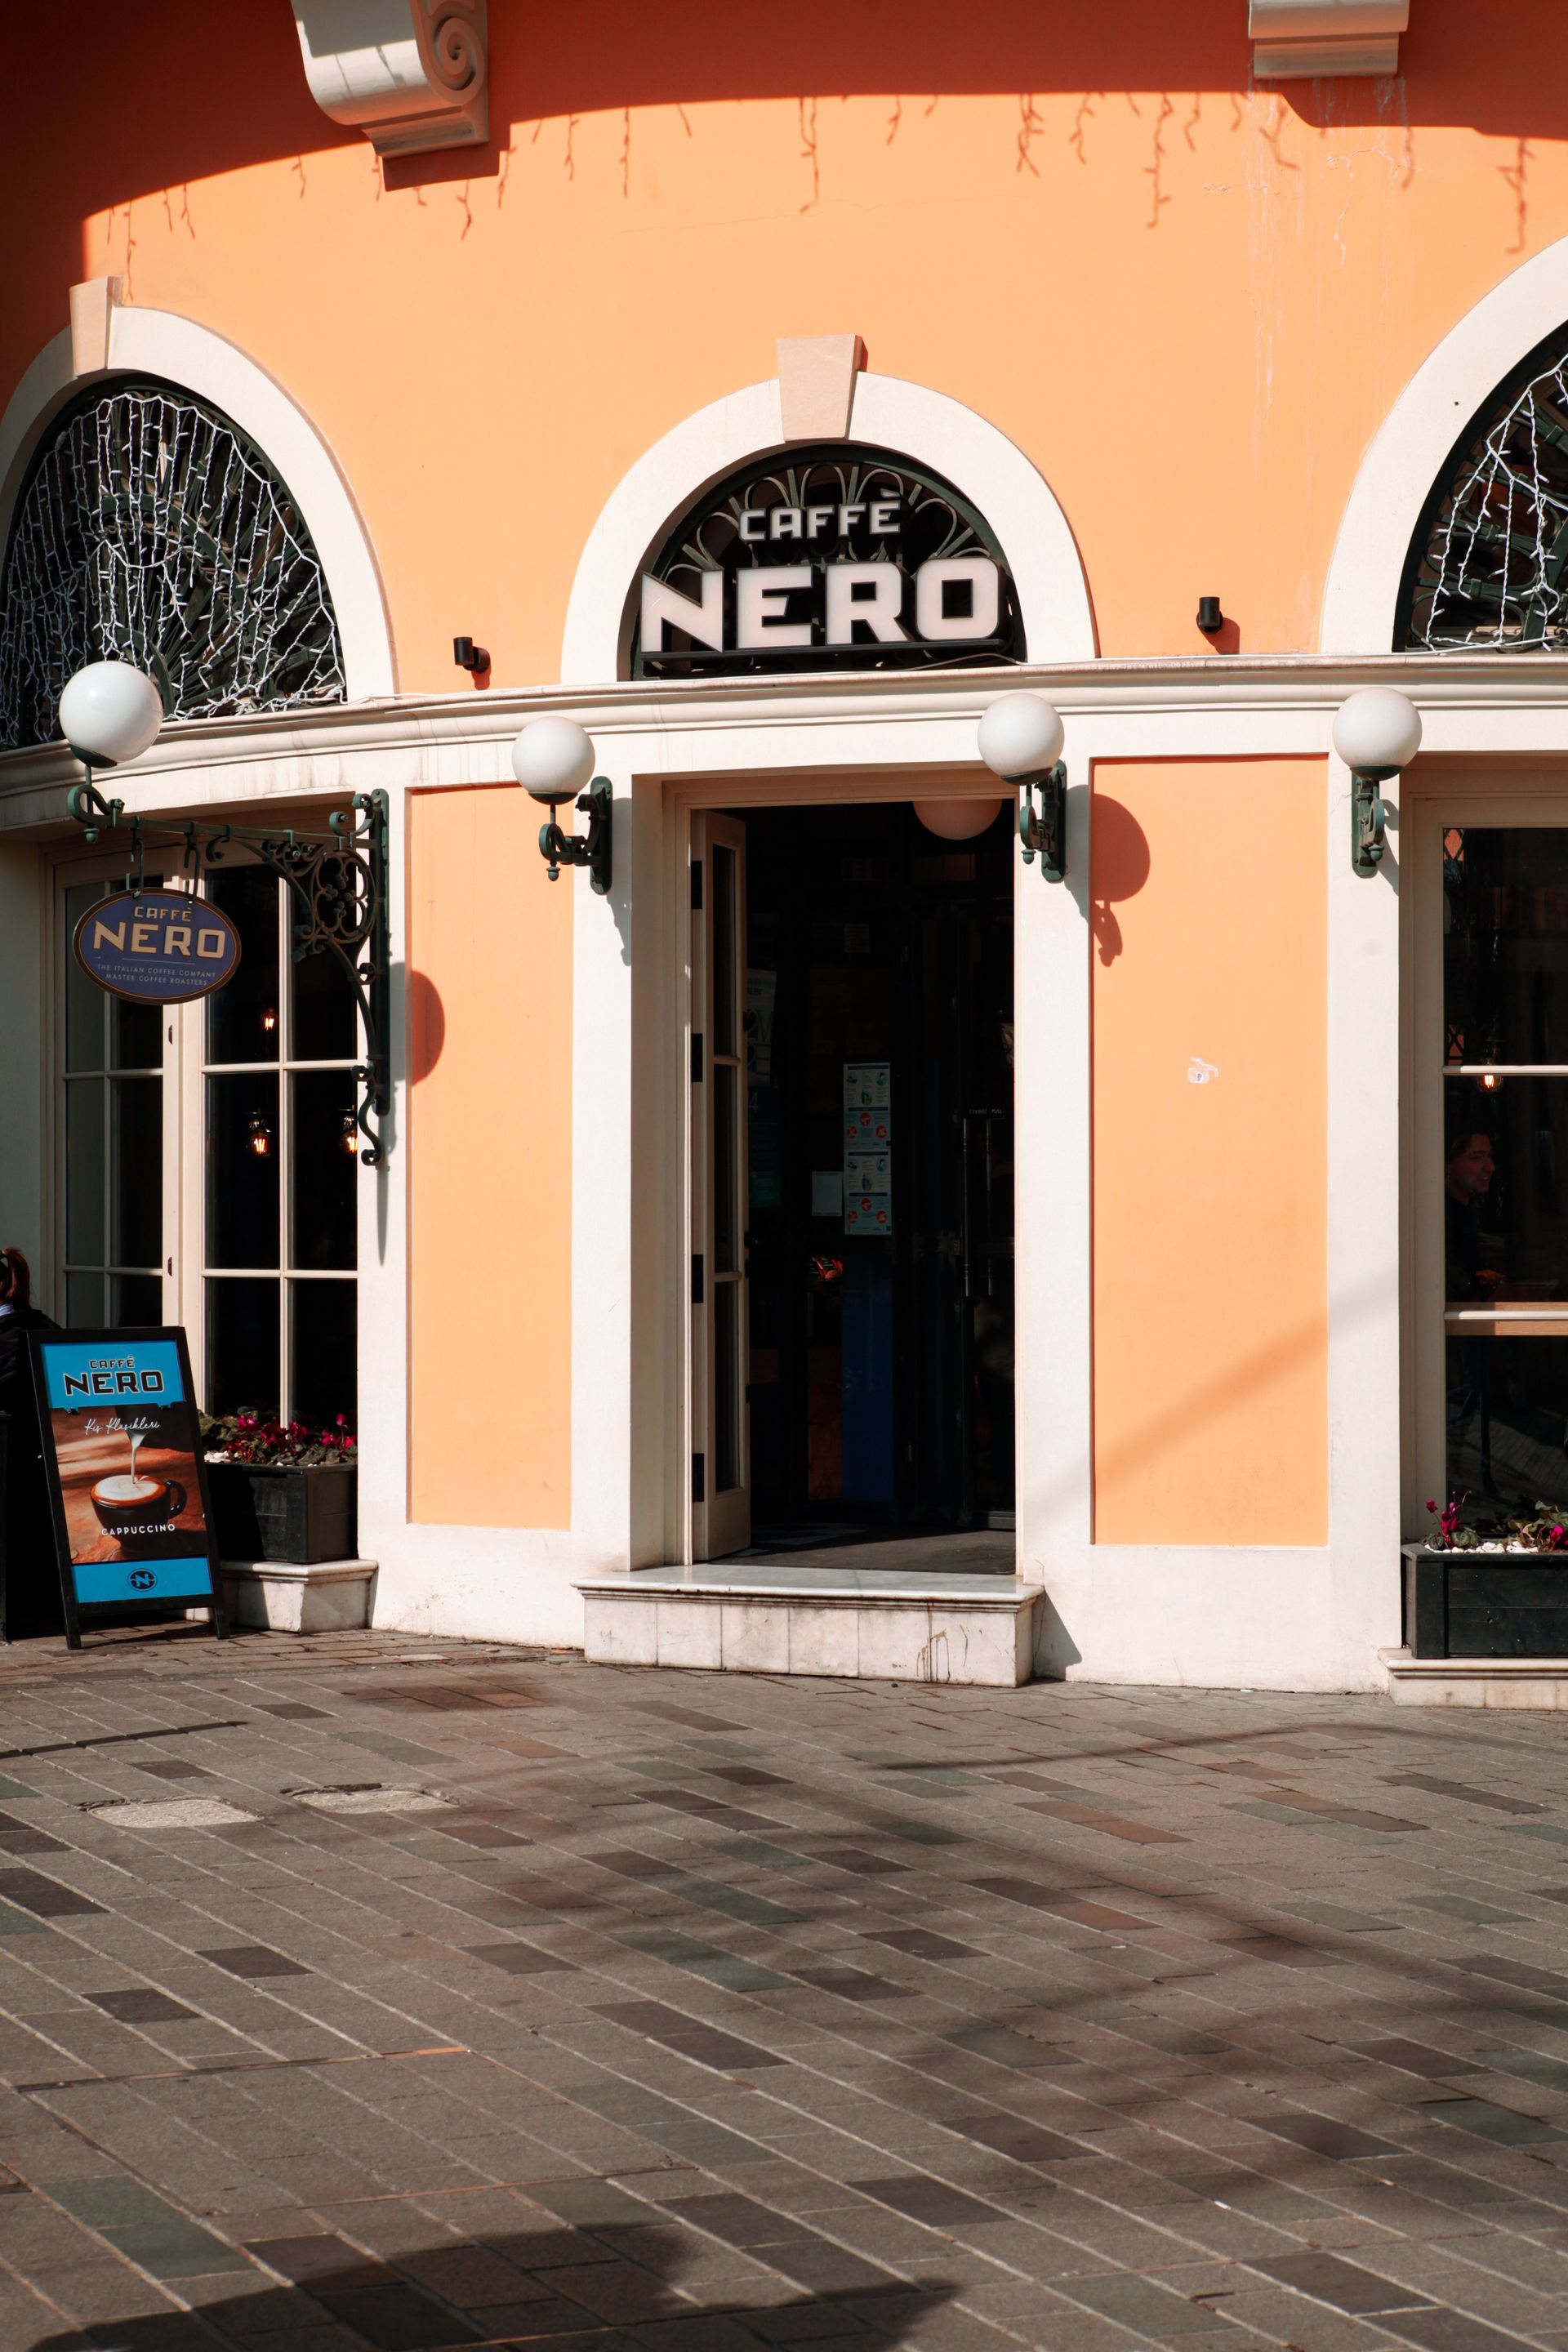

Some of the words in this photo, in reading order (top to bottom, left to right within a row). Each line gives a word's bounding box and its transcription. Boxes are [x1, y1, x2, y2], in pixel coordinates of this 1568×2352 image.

[738, 488, 902, 541] CAFFÈ
[640, 557, 1000, 653] NERO
[134, 906, 193, 922] CAFFÈ
[93, 920, 226, 959] NERO
[114, 965, 145, 973] ITALIAN
[179, 969, 216, 978] COMPANY
[89, 1356, 136, 1369] CAFFÈ
[63, 1370, 164, 1396] NERO
[106, 1417, 160, 1434] Klasikleri
[101, 1523, 176, 1535] CAPPUCCINO
